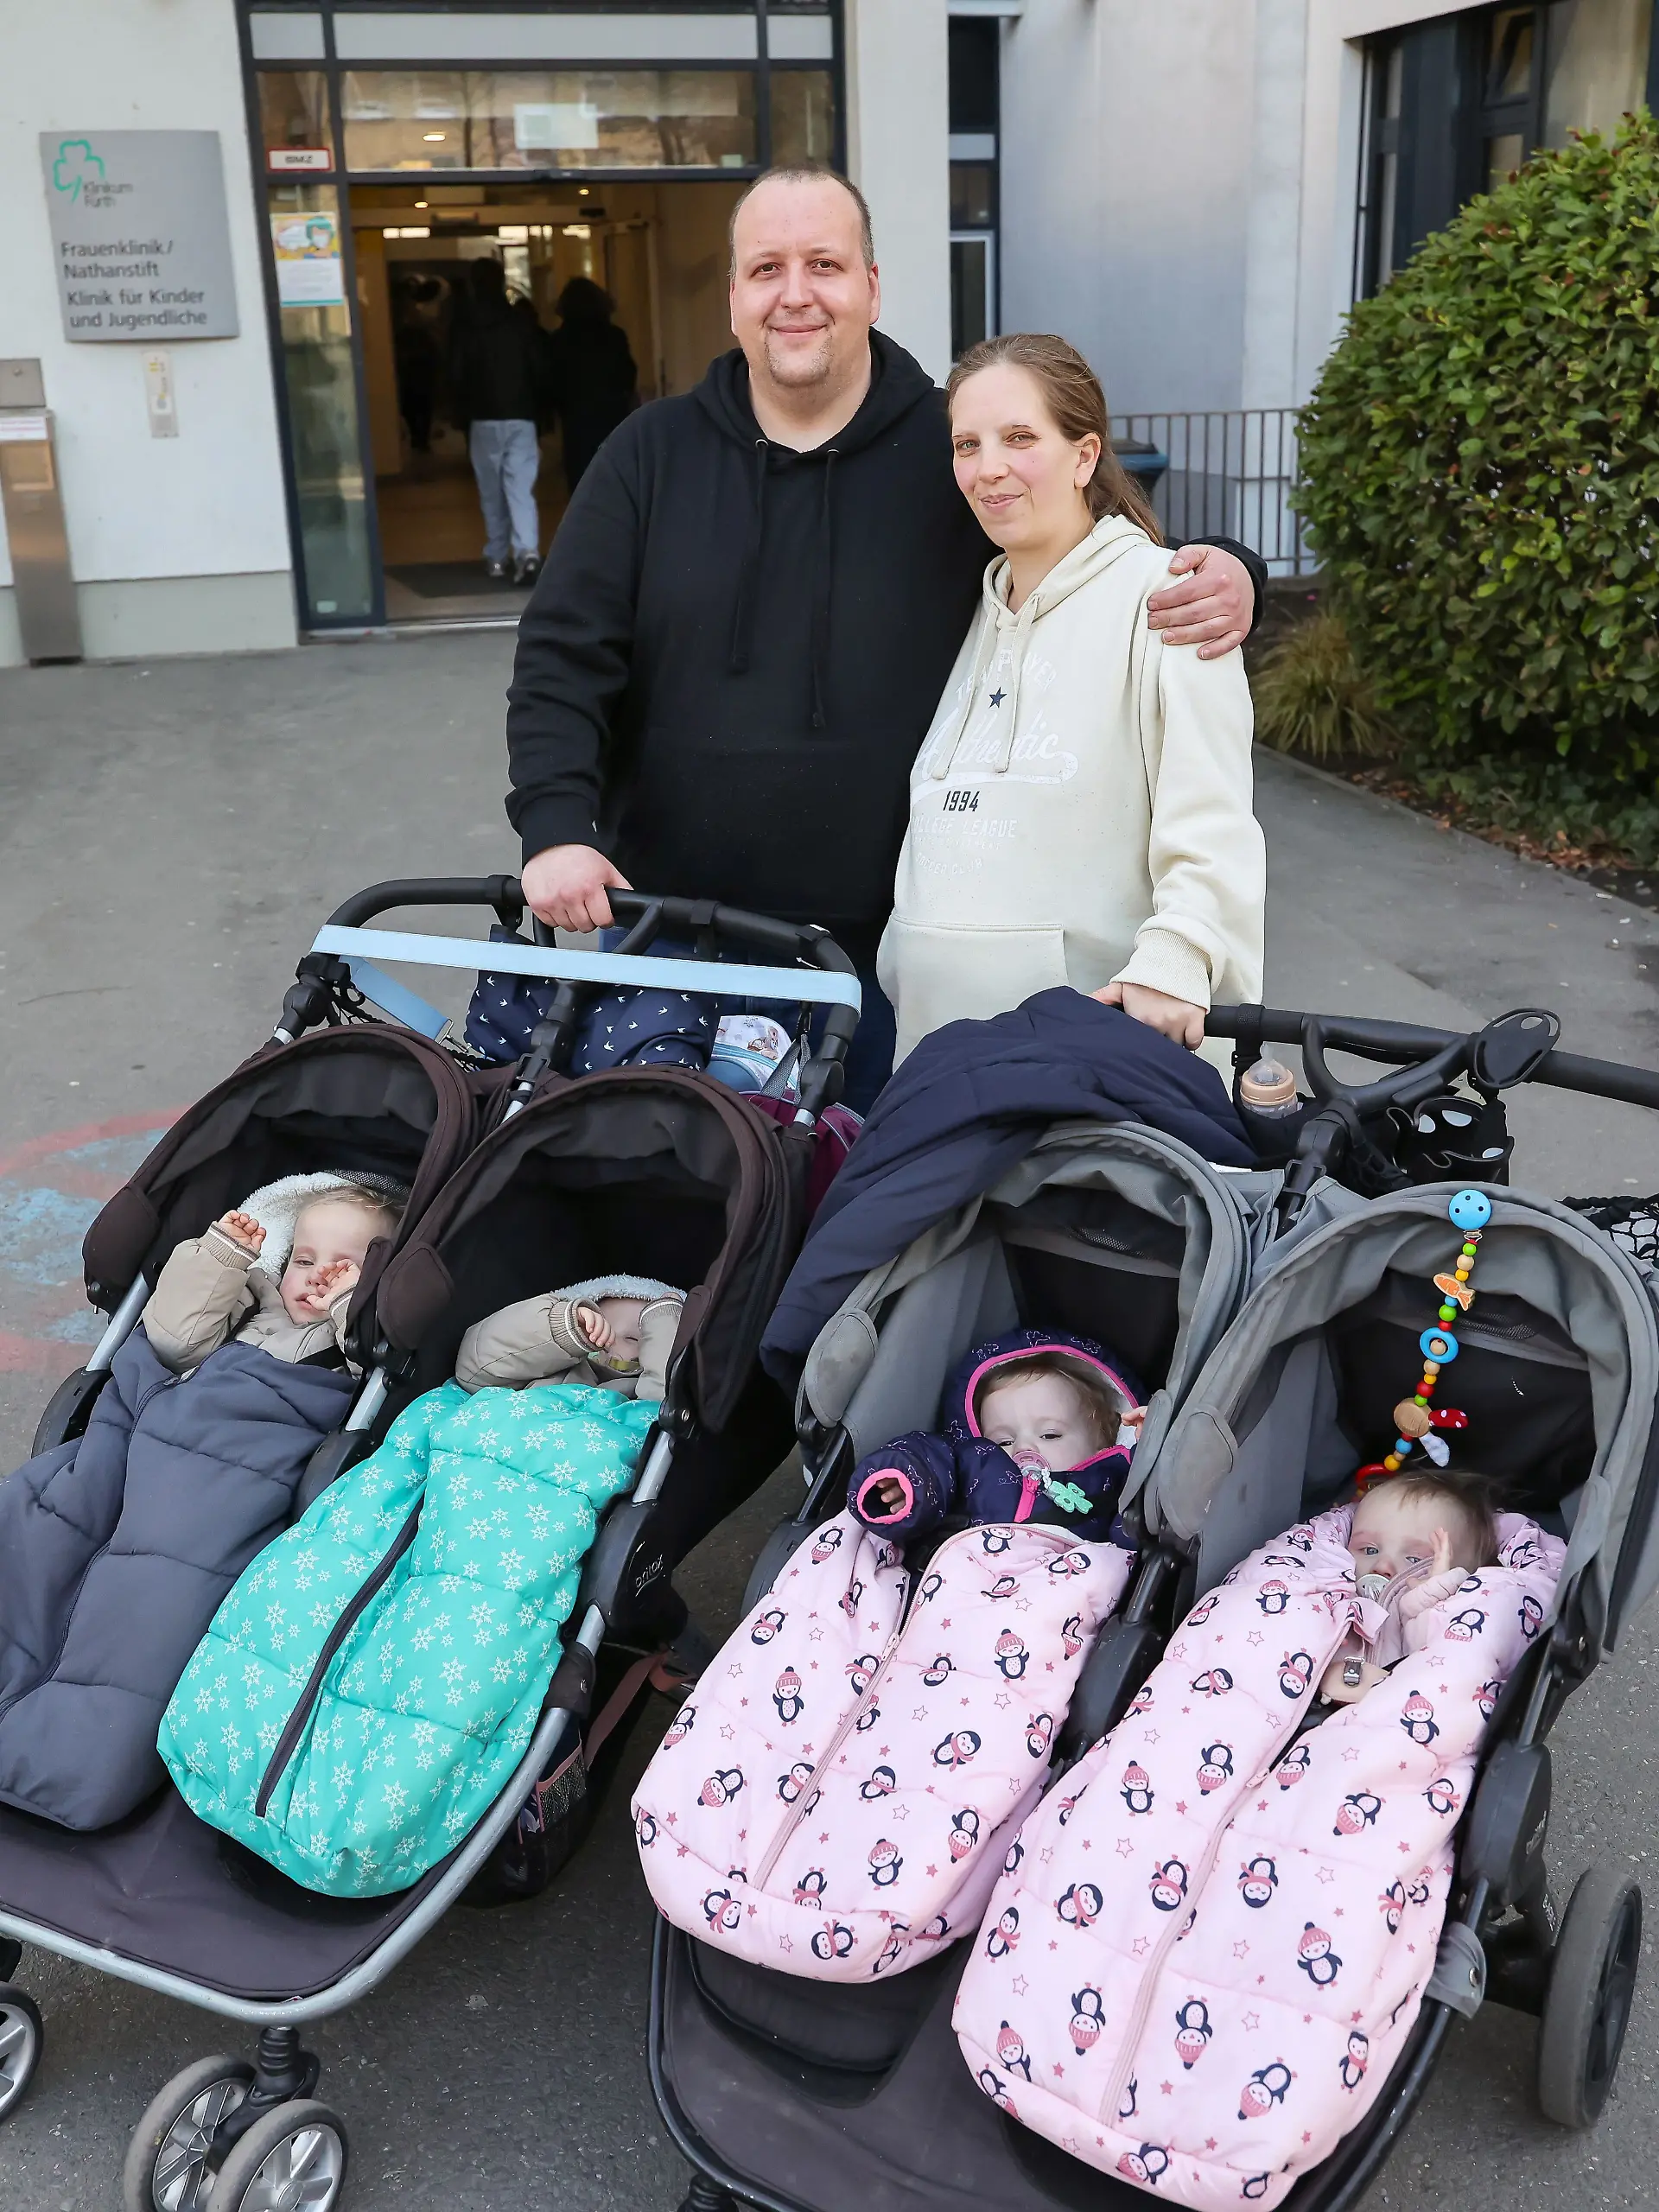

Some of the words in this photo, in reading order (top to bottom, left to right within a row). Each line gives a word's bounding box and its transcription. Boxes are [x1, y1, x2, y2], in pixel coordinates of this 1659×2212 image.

[83, 181, 133, 194] Klinikum
[60, 239, 173, 257] Frauenklinik/
[63, 261, 160, 279] Nathanstift
[67, 289, 113, 307] Klinik
[119, 289, 143, 305] für
[149, 287, 206, 305] Kinder
[69, 312, 102, 328] und
[108, 309, 207, 332] Jugendliche
[943, 790, 980, 812] 1994
[962, 818, 1019, 838] LEAGUE
